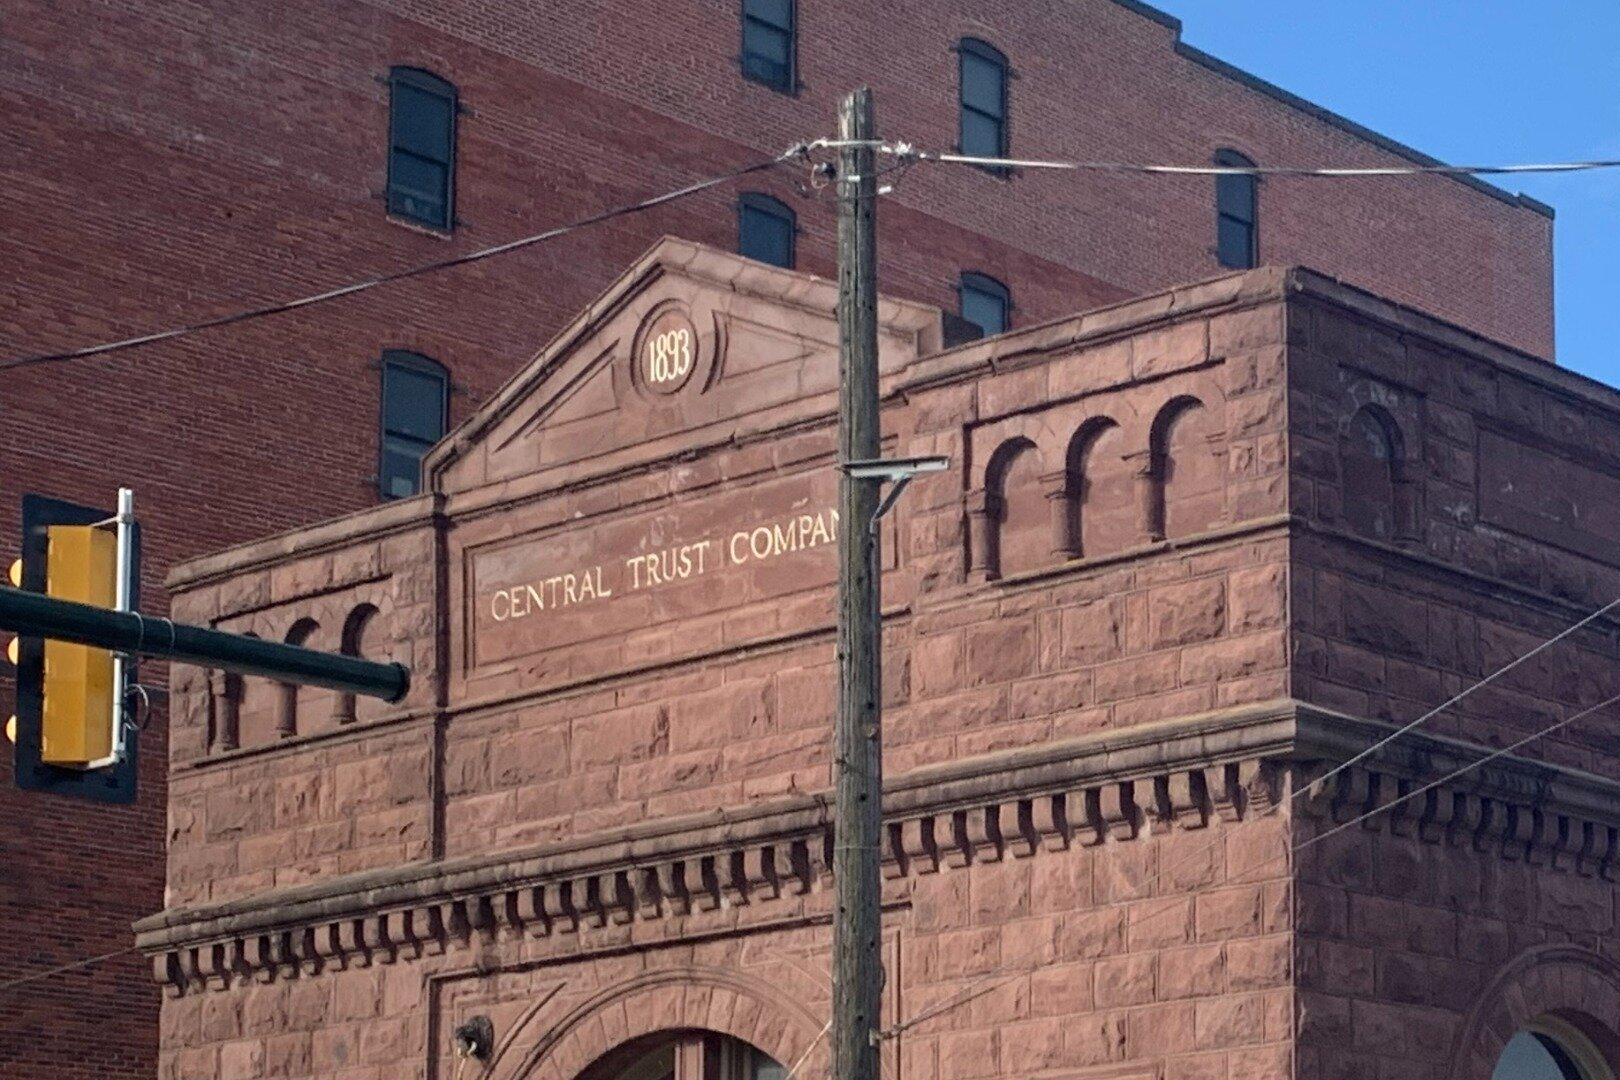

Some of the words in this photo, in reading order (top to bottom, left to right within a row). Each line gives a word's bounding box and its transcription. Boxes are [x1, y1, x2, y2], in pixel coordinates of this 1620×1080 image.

[649, 328, 690, 382] 1893
[491, 566, 612, 622] CENTRAL
[626, 541, 710, 590] TRUST
[730, 508, 840, 566] COMPA
